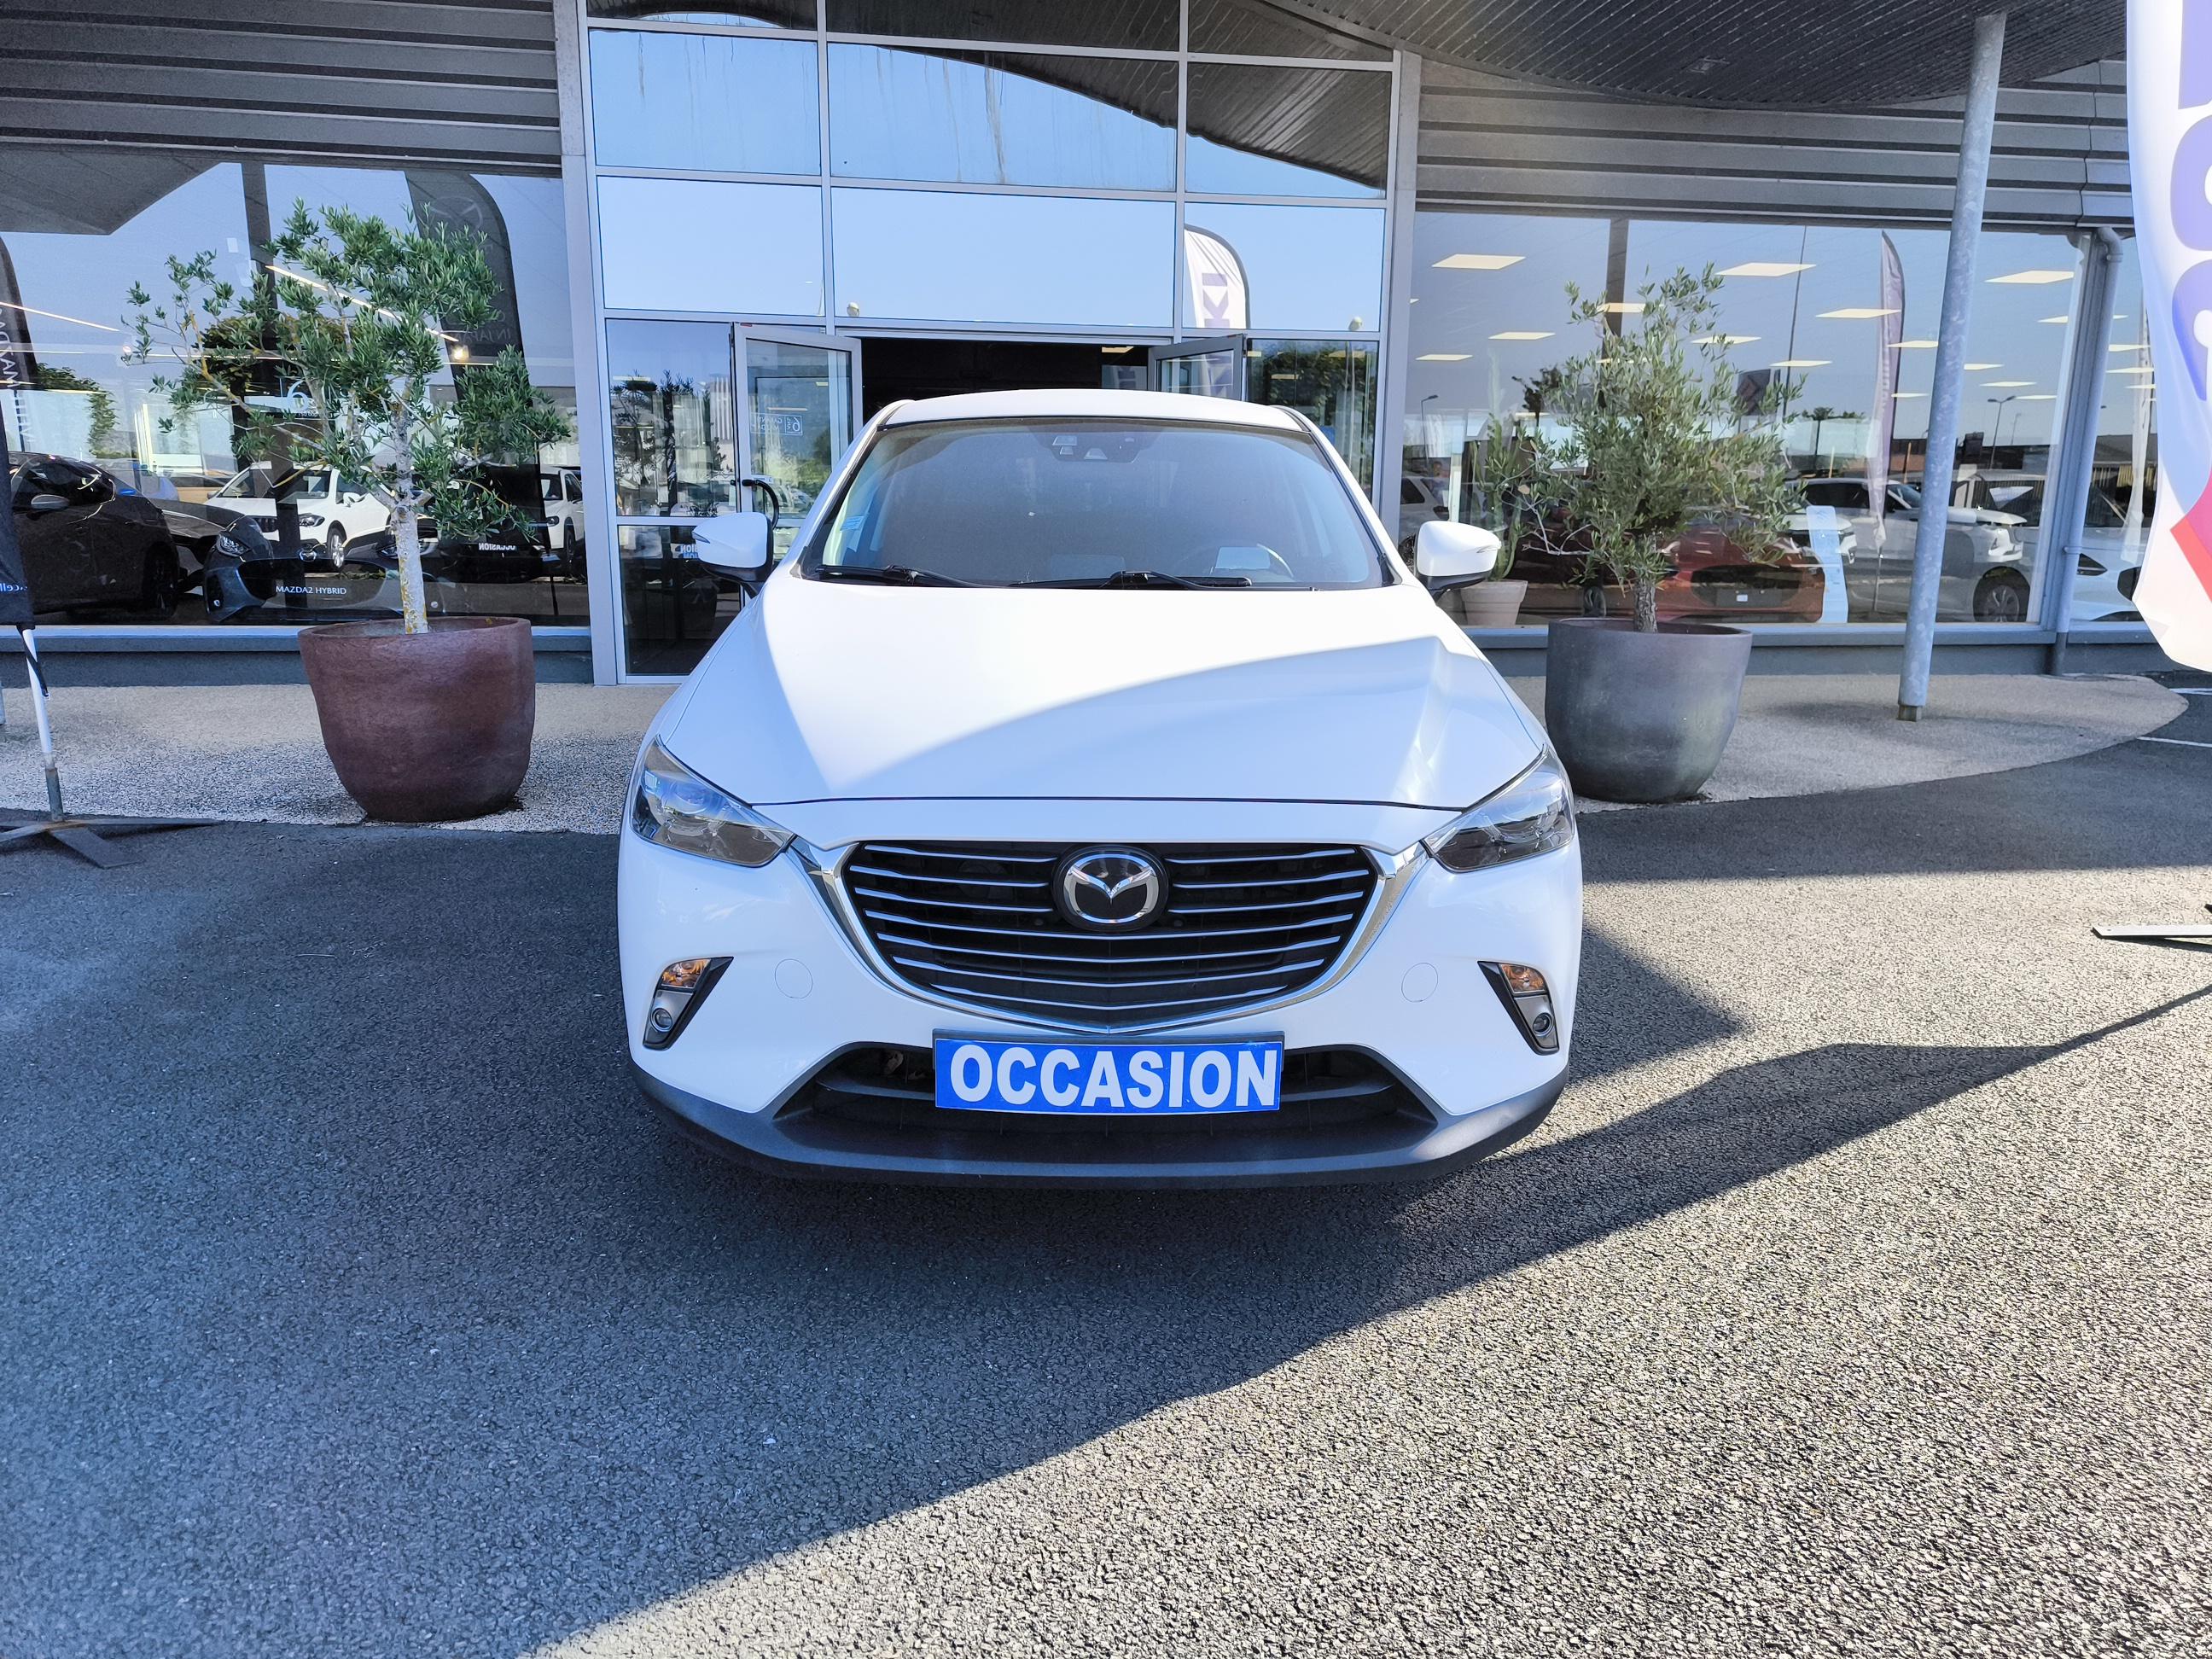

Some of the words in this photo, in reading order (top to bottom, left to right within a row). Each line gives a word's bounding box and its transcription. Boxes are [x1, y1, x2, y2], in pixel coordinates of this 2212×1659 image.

[276, 585, 314, 594] MAZDA2
[315, 586, 347, 595] HYBRID
[949, 1044, 1278, 1109] OCCASION
